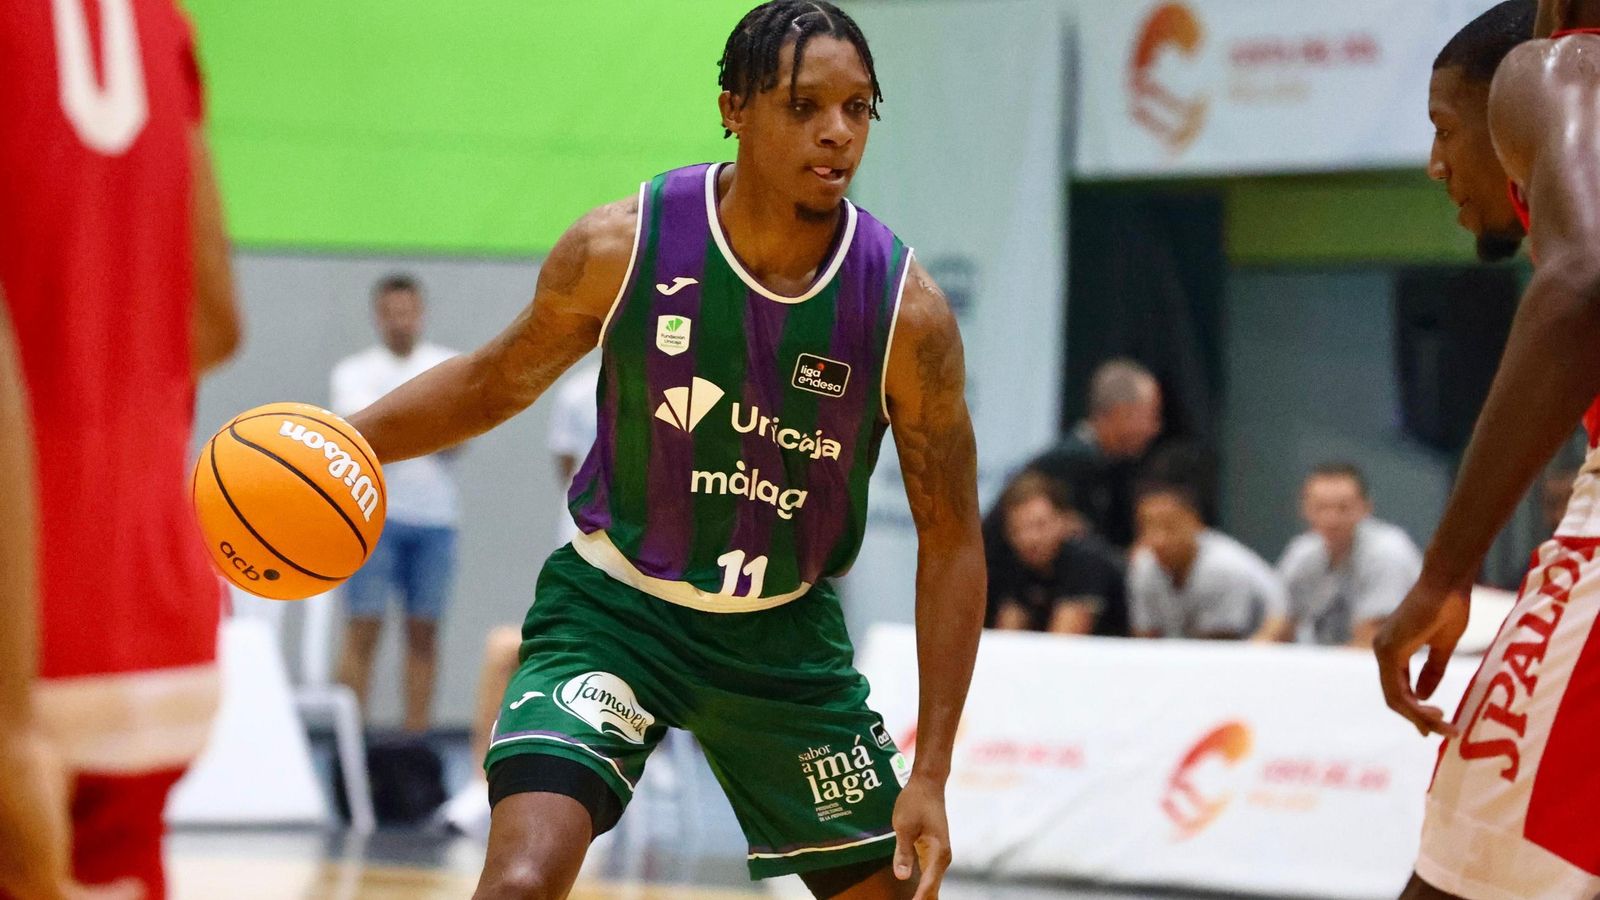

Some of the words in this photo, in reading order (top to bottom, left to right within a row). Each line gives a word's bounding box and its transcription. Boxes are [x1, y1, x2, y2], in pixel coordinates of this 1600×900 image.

[798, 376, 841, 392] endesa
[800, 365, 821, 378] liga
[279, 420, 379, 523] Wilson
[219, 541, 260, 581] acb
[717, 549, 768, 599] 11
[798, 745, 831, 762] sabor
[802, 762, 813, 773] a
[814, 734, 874, 780] má
[806, 768, 882, 804] laga
